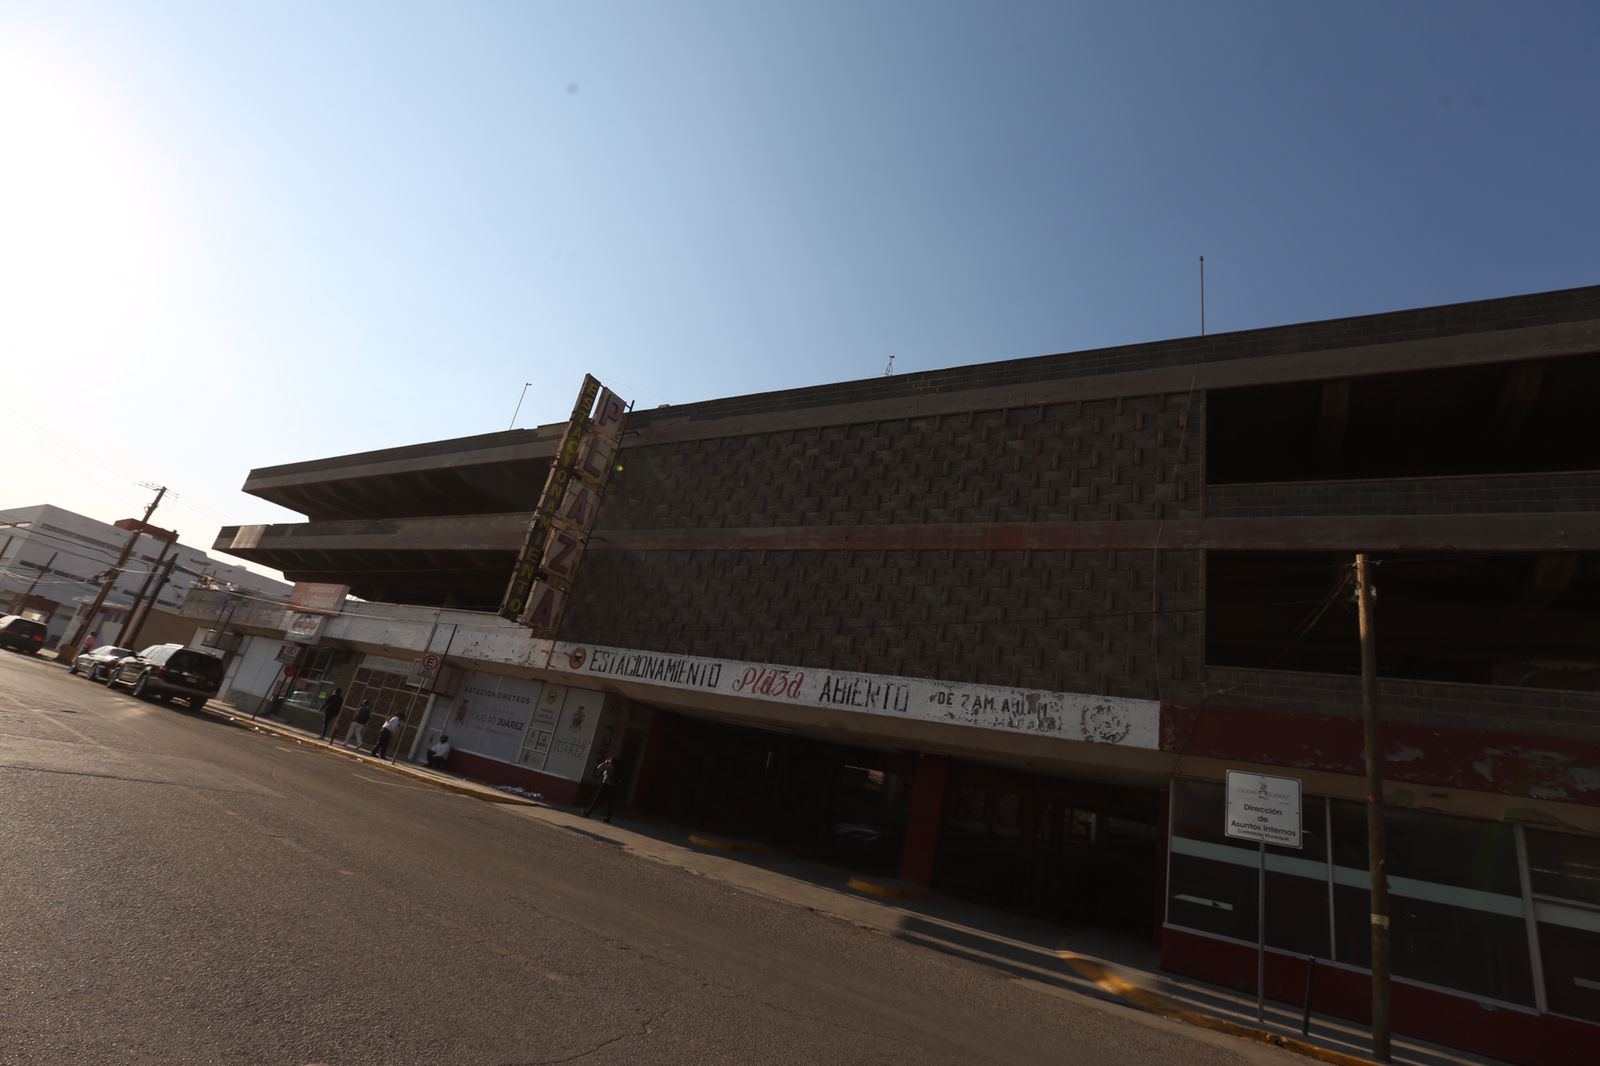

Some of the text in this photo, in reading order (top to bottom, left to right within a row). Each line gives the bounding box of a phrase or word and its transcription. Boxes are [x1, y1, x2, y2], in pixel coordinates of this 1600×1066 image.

[531, 394, 620, 627] PLAZA
[426, 658, 435, 668] E
[589, 649, 722, 689] ESTACIONAMIENTO
[819, 674, 910, 713] ABIERTO
[937, 691, 954, 705] DE
[1243, 803, 1283, 816] Dirección
[1231, 820, 1261, 831] Asuntos
[1263, 825, 1297, 836] Internos
